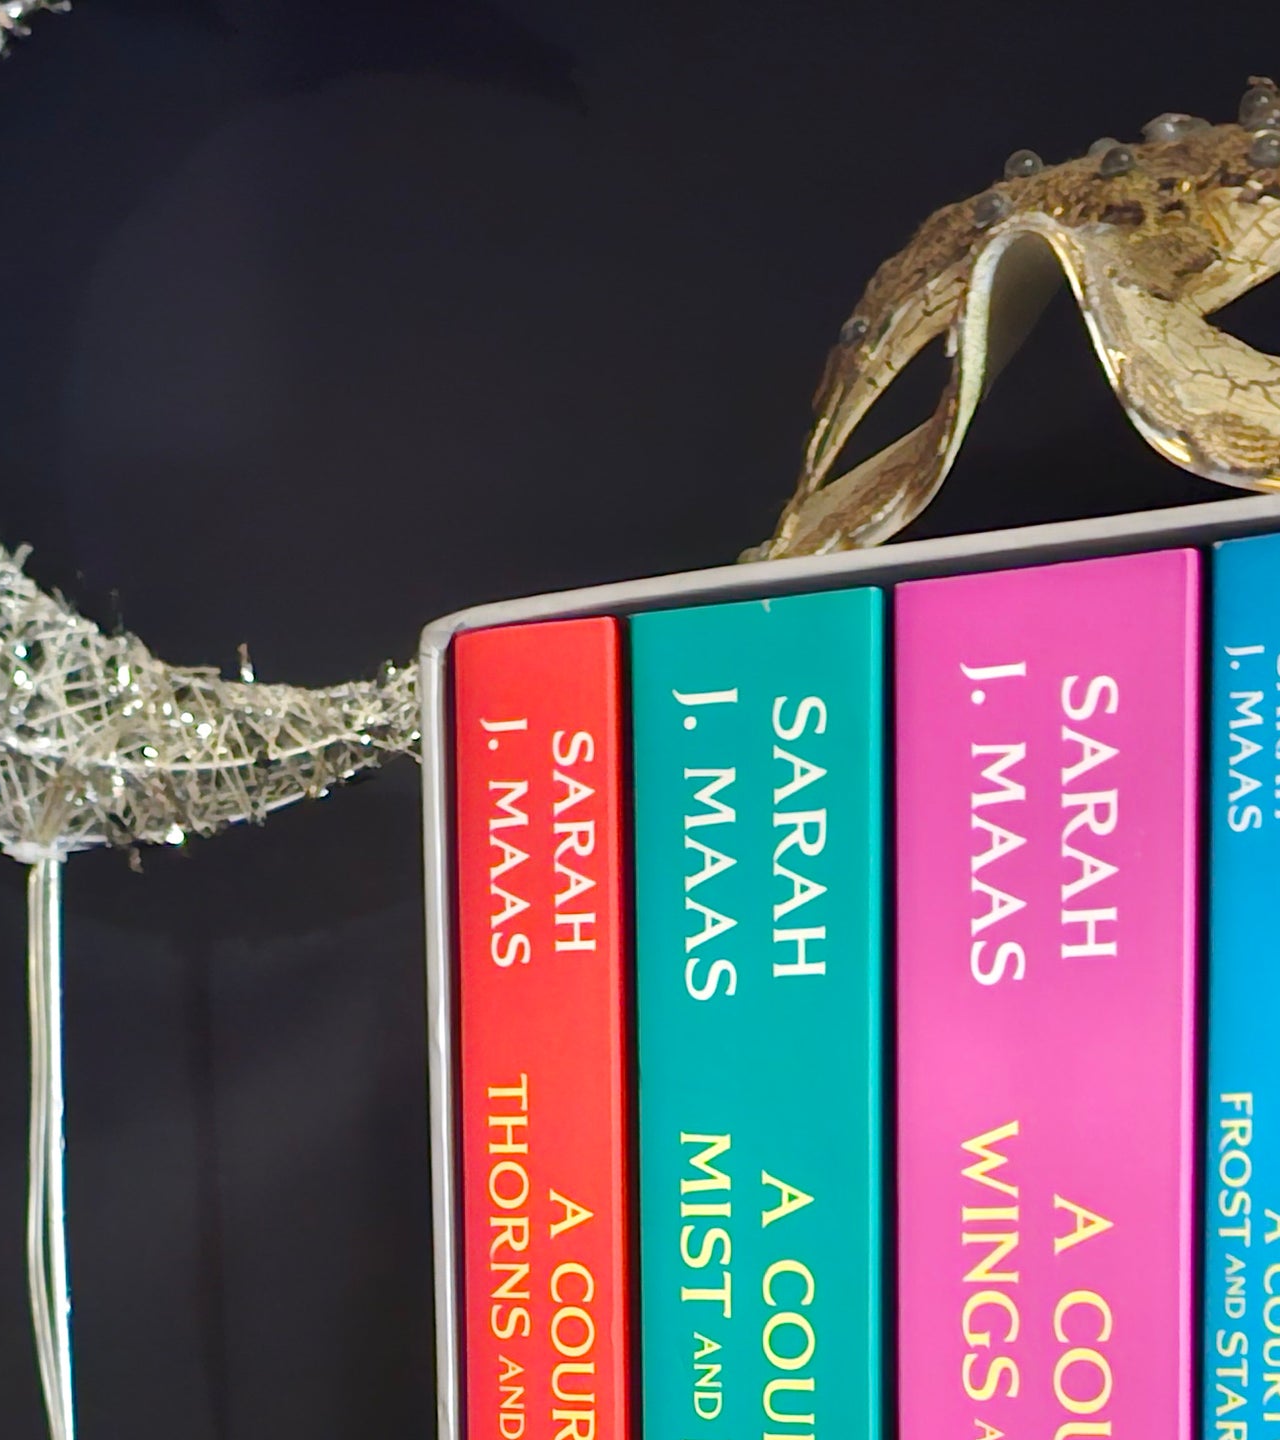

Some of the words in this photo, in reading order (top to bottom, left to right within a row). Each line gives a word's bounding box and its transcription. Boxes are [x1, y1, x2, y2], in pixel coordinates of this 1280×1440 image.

[672, 687, 739, 731] J.
[960, 661, 1027, 706] J.
[1224, 643, 1265, 671] J.
[480, 717, 528, 751] J.
[1227, 690, 1264, 833] MAAS
[488, 779, 532, 968] MAAS
[552, 730, 597, 953] SARAH
[683, 765, 739, 1001] MAAS
[771, 695, 828, 977] SARAH
[970, 741, 1028, 986] MAAS
[1060, 674, 1120, 960] SARAH
[487, 1072, 531, 1341] THORNS
[549, 1188, 594, 1240] A
[680, 1131, 732, 1319] MIST
[761, 1169, 816, 1229] A
[1053, 1193, 1114, 1257] A
[1218, 1091, 1253, 1247] FROST
[960, 1120, 1019, 1402] WINGS
[1224, 1253, 1247, 1319] AND
[498, 1355, 526, 1440] AND
[693, 1331, 723, 1421] AND
